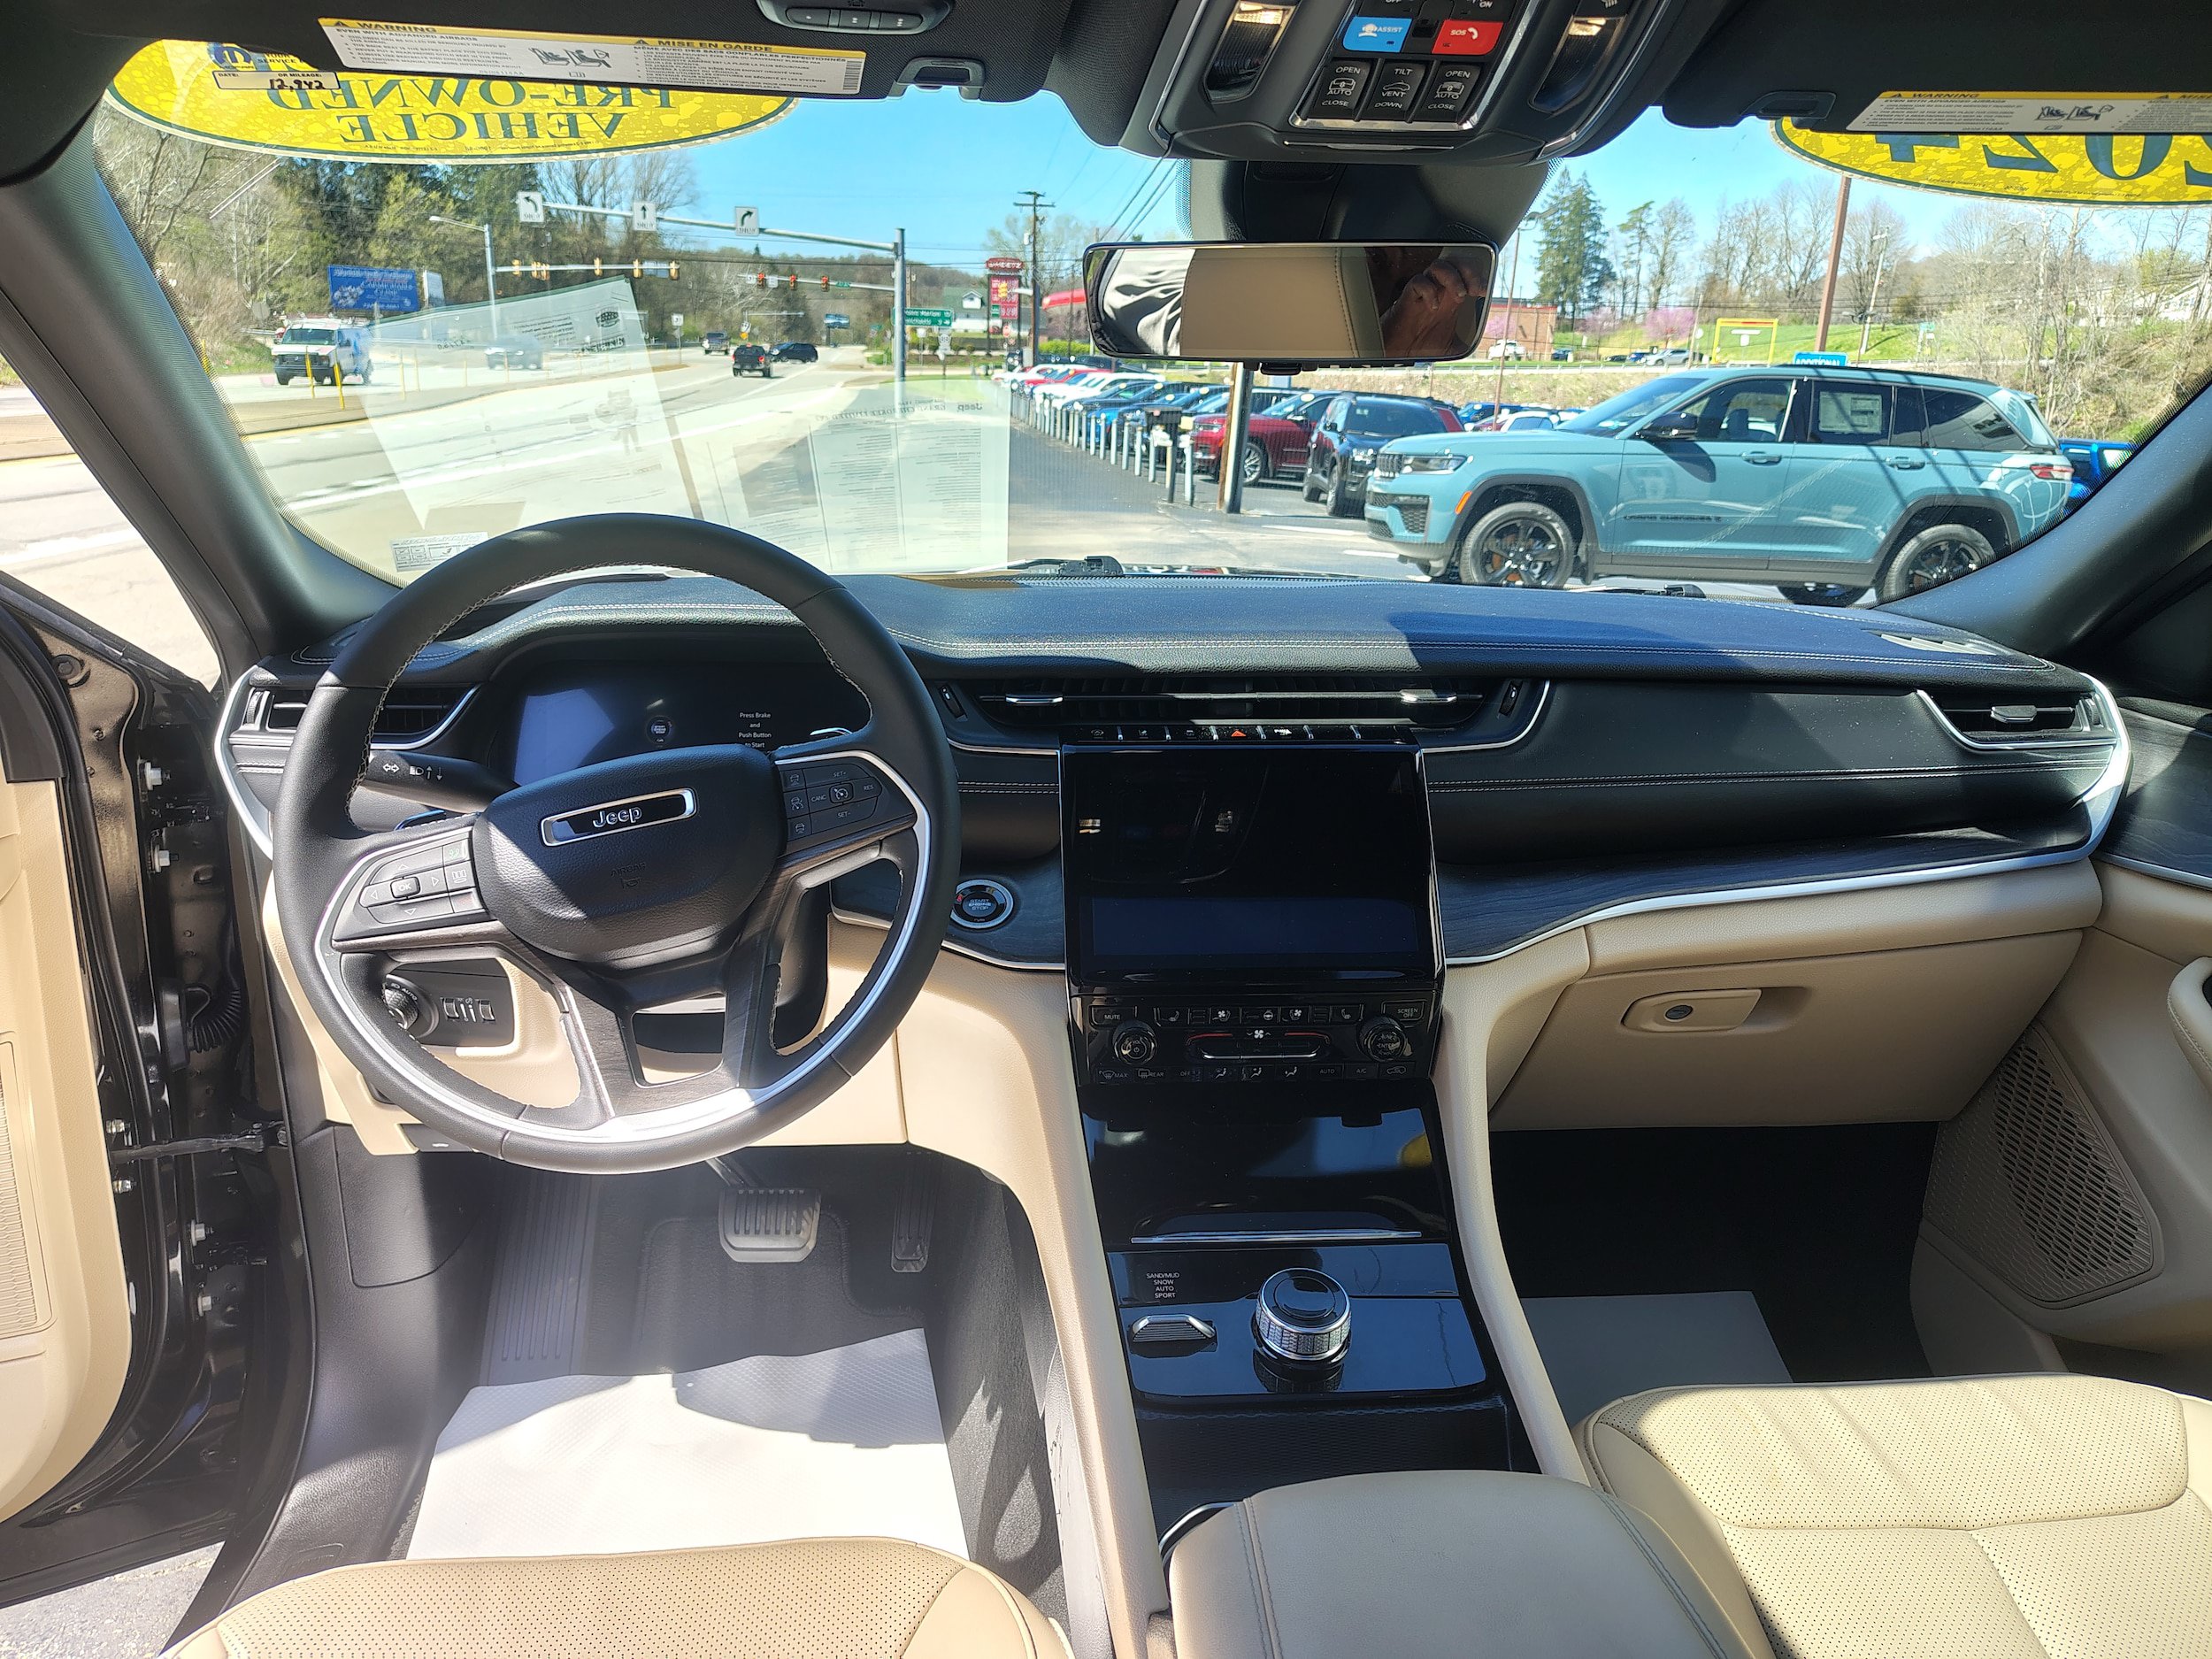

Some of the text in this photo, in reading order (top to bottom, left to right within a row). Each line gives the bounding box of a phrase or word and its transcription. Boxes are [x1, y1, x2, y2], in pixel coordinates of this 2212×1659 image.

[357, 22, 437, 33] WARNING
[657, 40, 695, 49] MISE
[722, 43, 773, 52] GARDE
[592, 806, 642, 828] Jeep
[398, 882, 411, 892] OK
[402, 987, 418, 1001] AUTO
